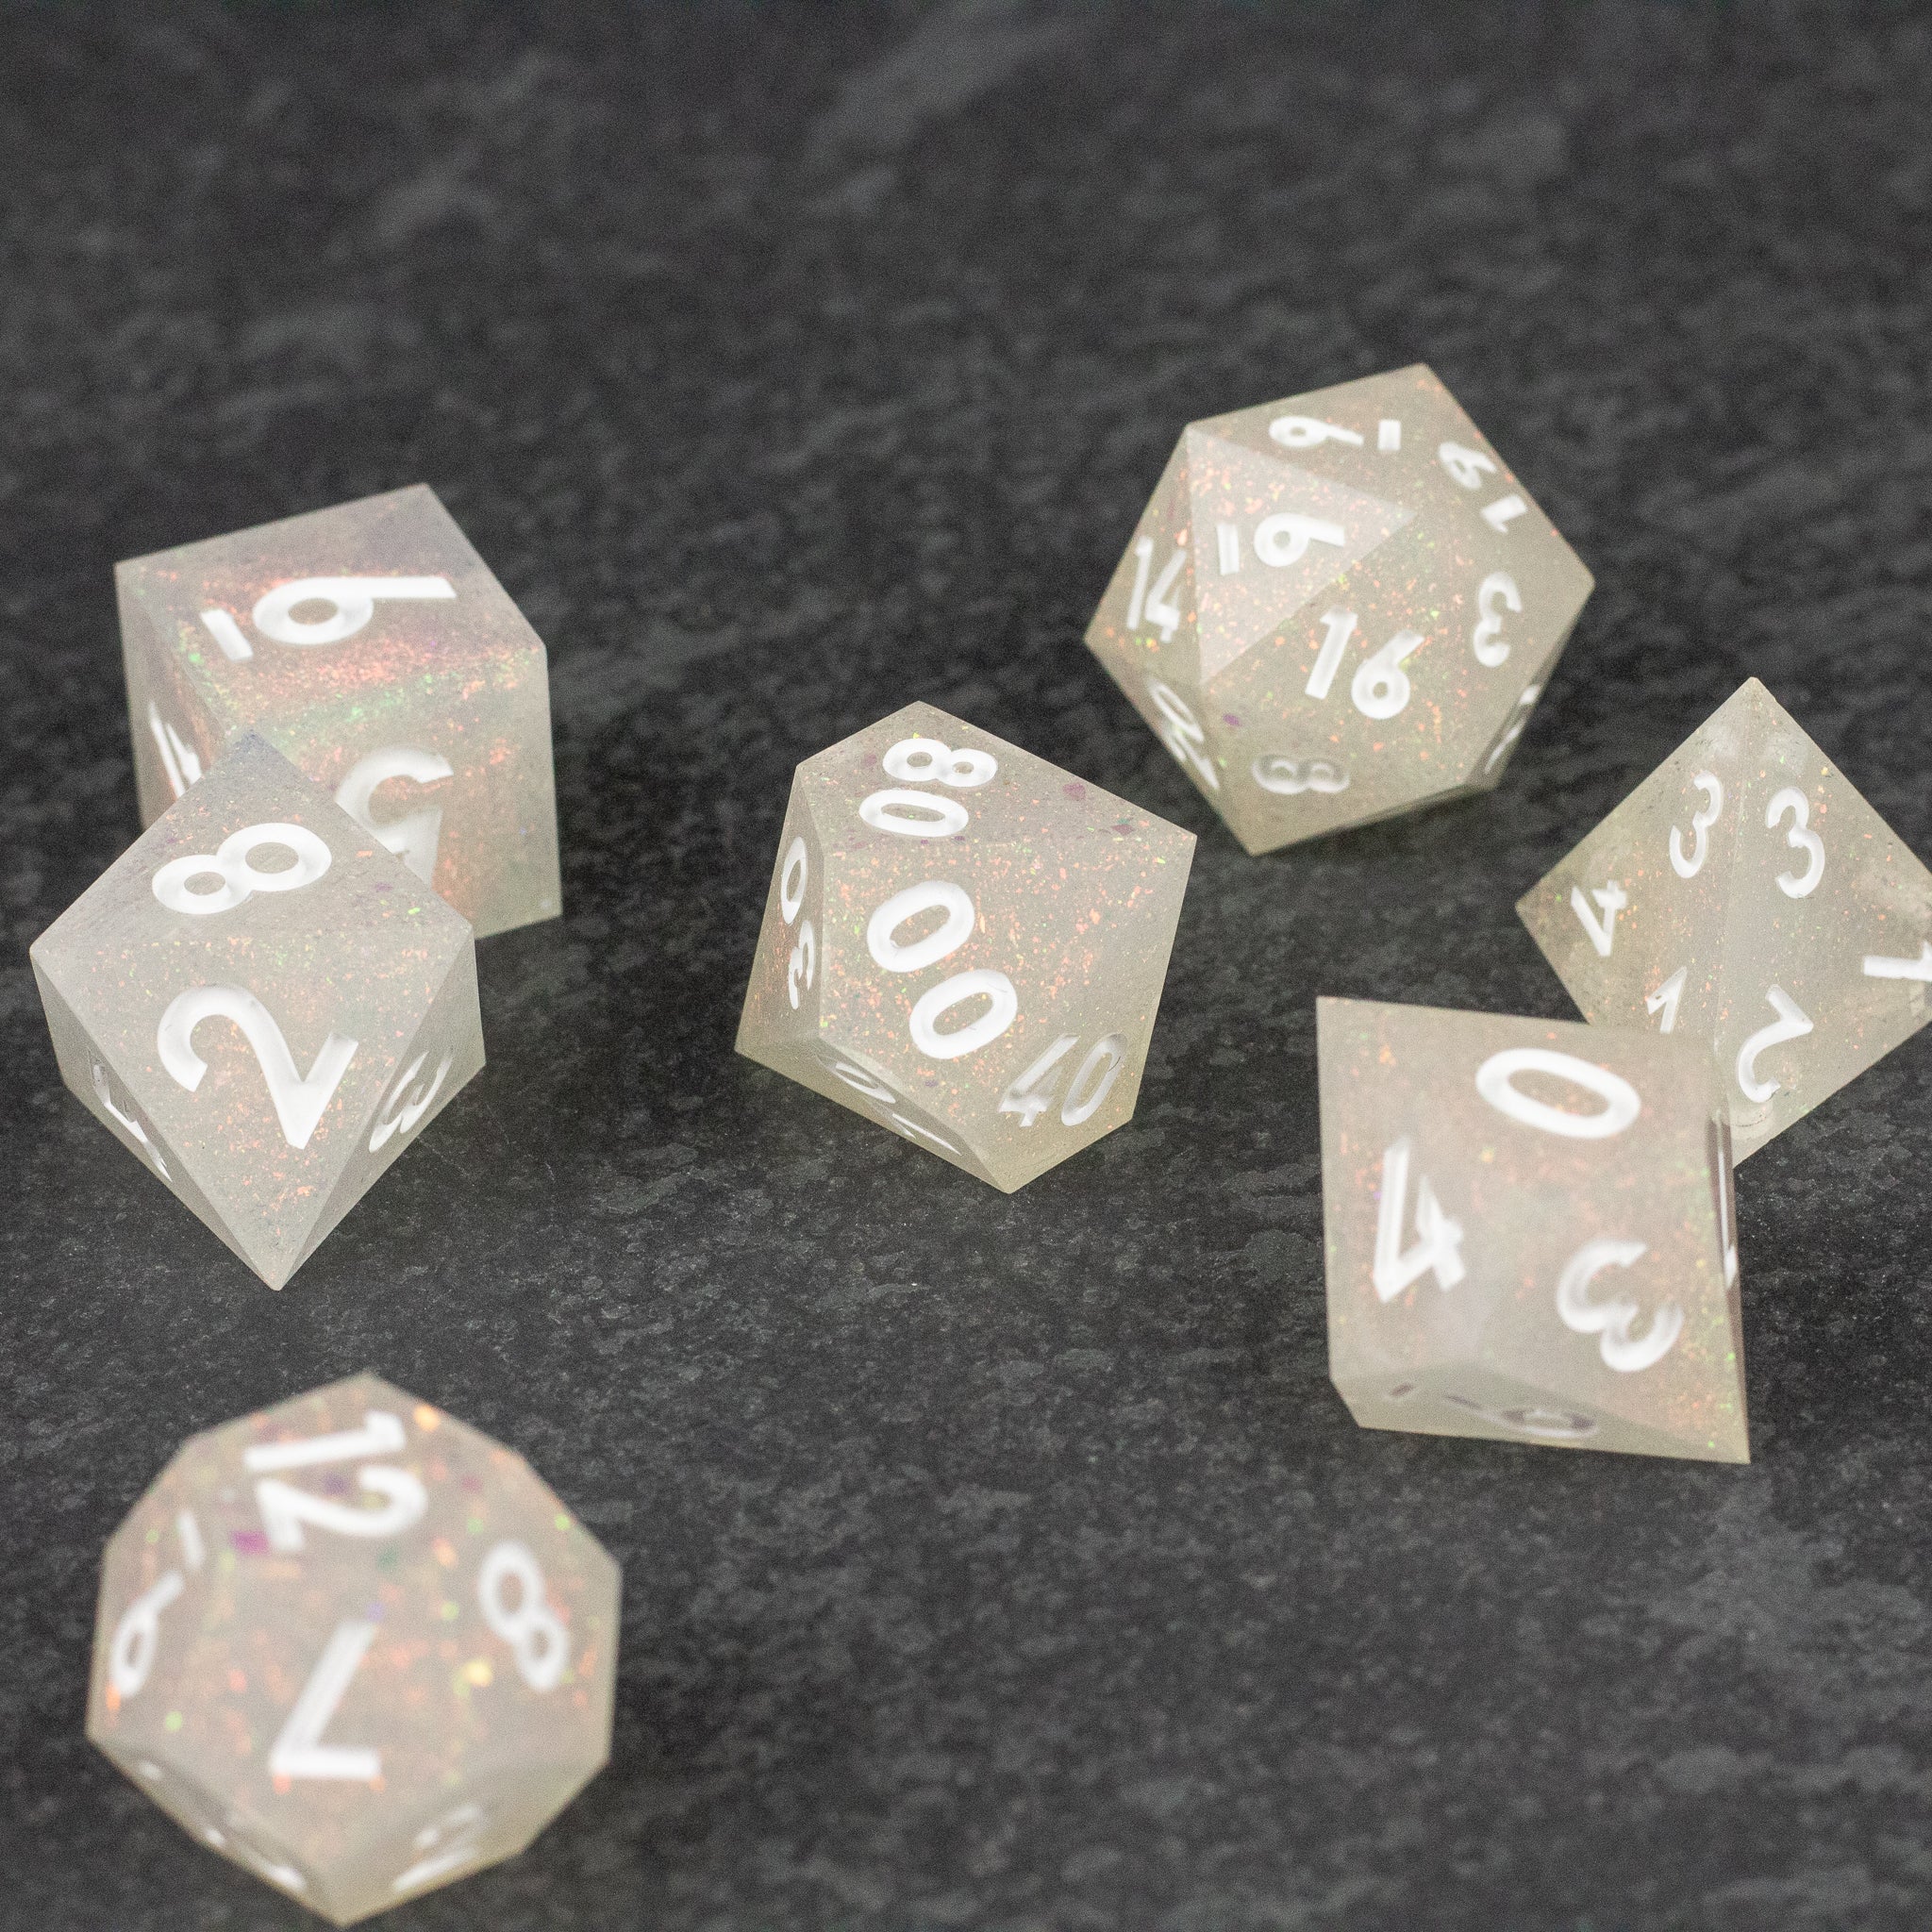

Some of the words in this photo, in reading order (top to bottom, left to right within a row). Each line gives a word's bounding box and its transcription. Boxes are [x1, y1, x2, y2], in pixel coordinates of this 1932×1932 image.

[1127, 536, 1187, 643] 14
[1473, 572, 1523, 668] 3
[1305, 606, 1425, 720] 16
[844, 738, 998, 838] 80
[1251, 756, 1352, 795] 8
[1669, 770, 1724, 879] 3
[151, 822, 333, 915] 8
[1765, 787, 1826, 899] 3
[866, 879, 1018, 1059] 00
[1570, 879, 1627, 958] 4
[157, 984, 358, 1151] 2
[998, 1033, 1128, 1127] 40
[1474, 1047, 1641, 1139] 0
[1737, 984, 1815, 1103] 2
[1372, 1136, 1468, 1304] 4
[1557, 1240, 1685, 1373] 3
[242, 1411, 429, 1551] 12
[478, 1541, 570, 1691] 8
[268, 1619, 381, 1779] 7
